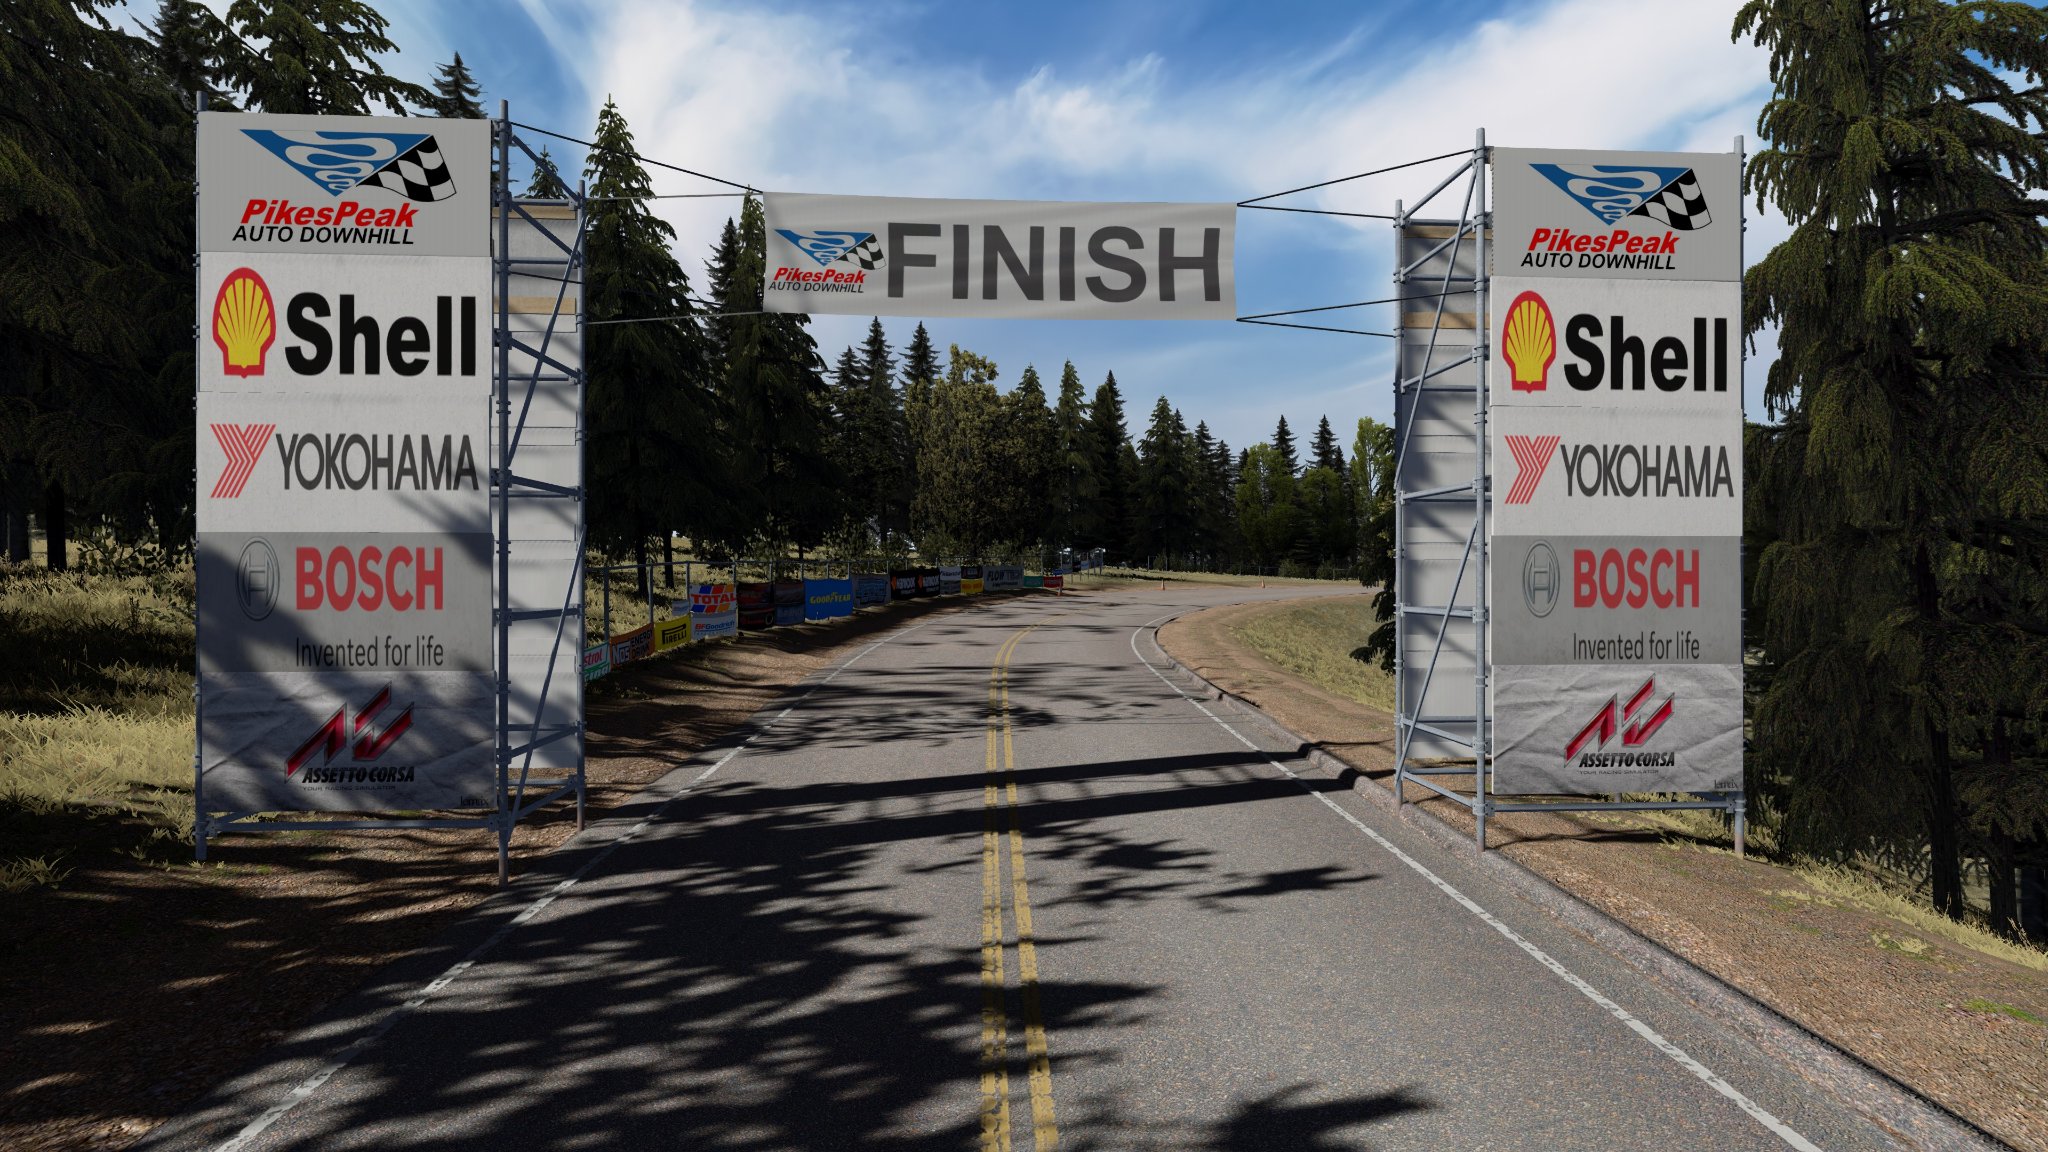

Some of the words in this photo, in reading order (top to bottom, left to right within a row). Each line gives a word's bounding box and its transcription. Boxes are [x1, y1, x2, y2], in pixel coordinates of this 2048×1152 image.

[241, 199, 419, 227] PikesPeak
[232, 225, 294, 243] AUTO
[300, 226, 414, 245] DOWNHILL
[1528, 228, 1680, 254] PikesPeak
[887, 222, 1221, 303] FINISH
[1521, 252, 1573, 268] AUTO
[1578, 253, 1676, 270] DOWNHILL
[768, 281, 800, 291] AUTO
[804, 282, 864, 293] DOWNHILL
[773, 267, 866, 284] PikesPeak
[285, 291, 476, 376] Shell
[1563, 313, 1727, 392] Shell
[275, 433, 479, 491] YOKOHAMA
[1560, 444, 1734, 497] YOKOHAMA
[296, 545, 443, 611] BOSCH
[1573, 548, 1699, 609] BOSCH
[691, 593, 736, 604] TOTAL
[662, 623, 687, 644] PIRELLI
[1573, 631, 1644, 660] Invented
[1649, 631, 1672, 660] for
[1676, 631, 1699, 660] life
[296, 635, 378, 666] Invented
[384, 635, 412, 666] for
[416, 635, 443, 666] life
[584, 648, 603, 666] strol
[1578, 752, 1635, 768] ASSETTO
[1636, 751, 1675, 767] CORSA
[302, 767, 367, 784] ASSETTO
[369, 766, 414, 783] CORSA
